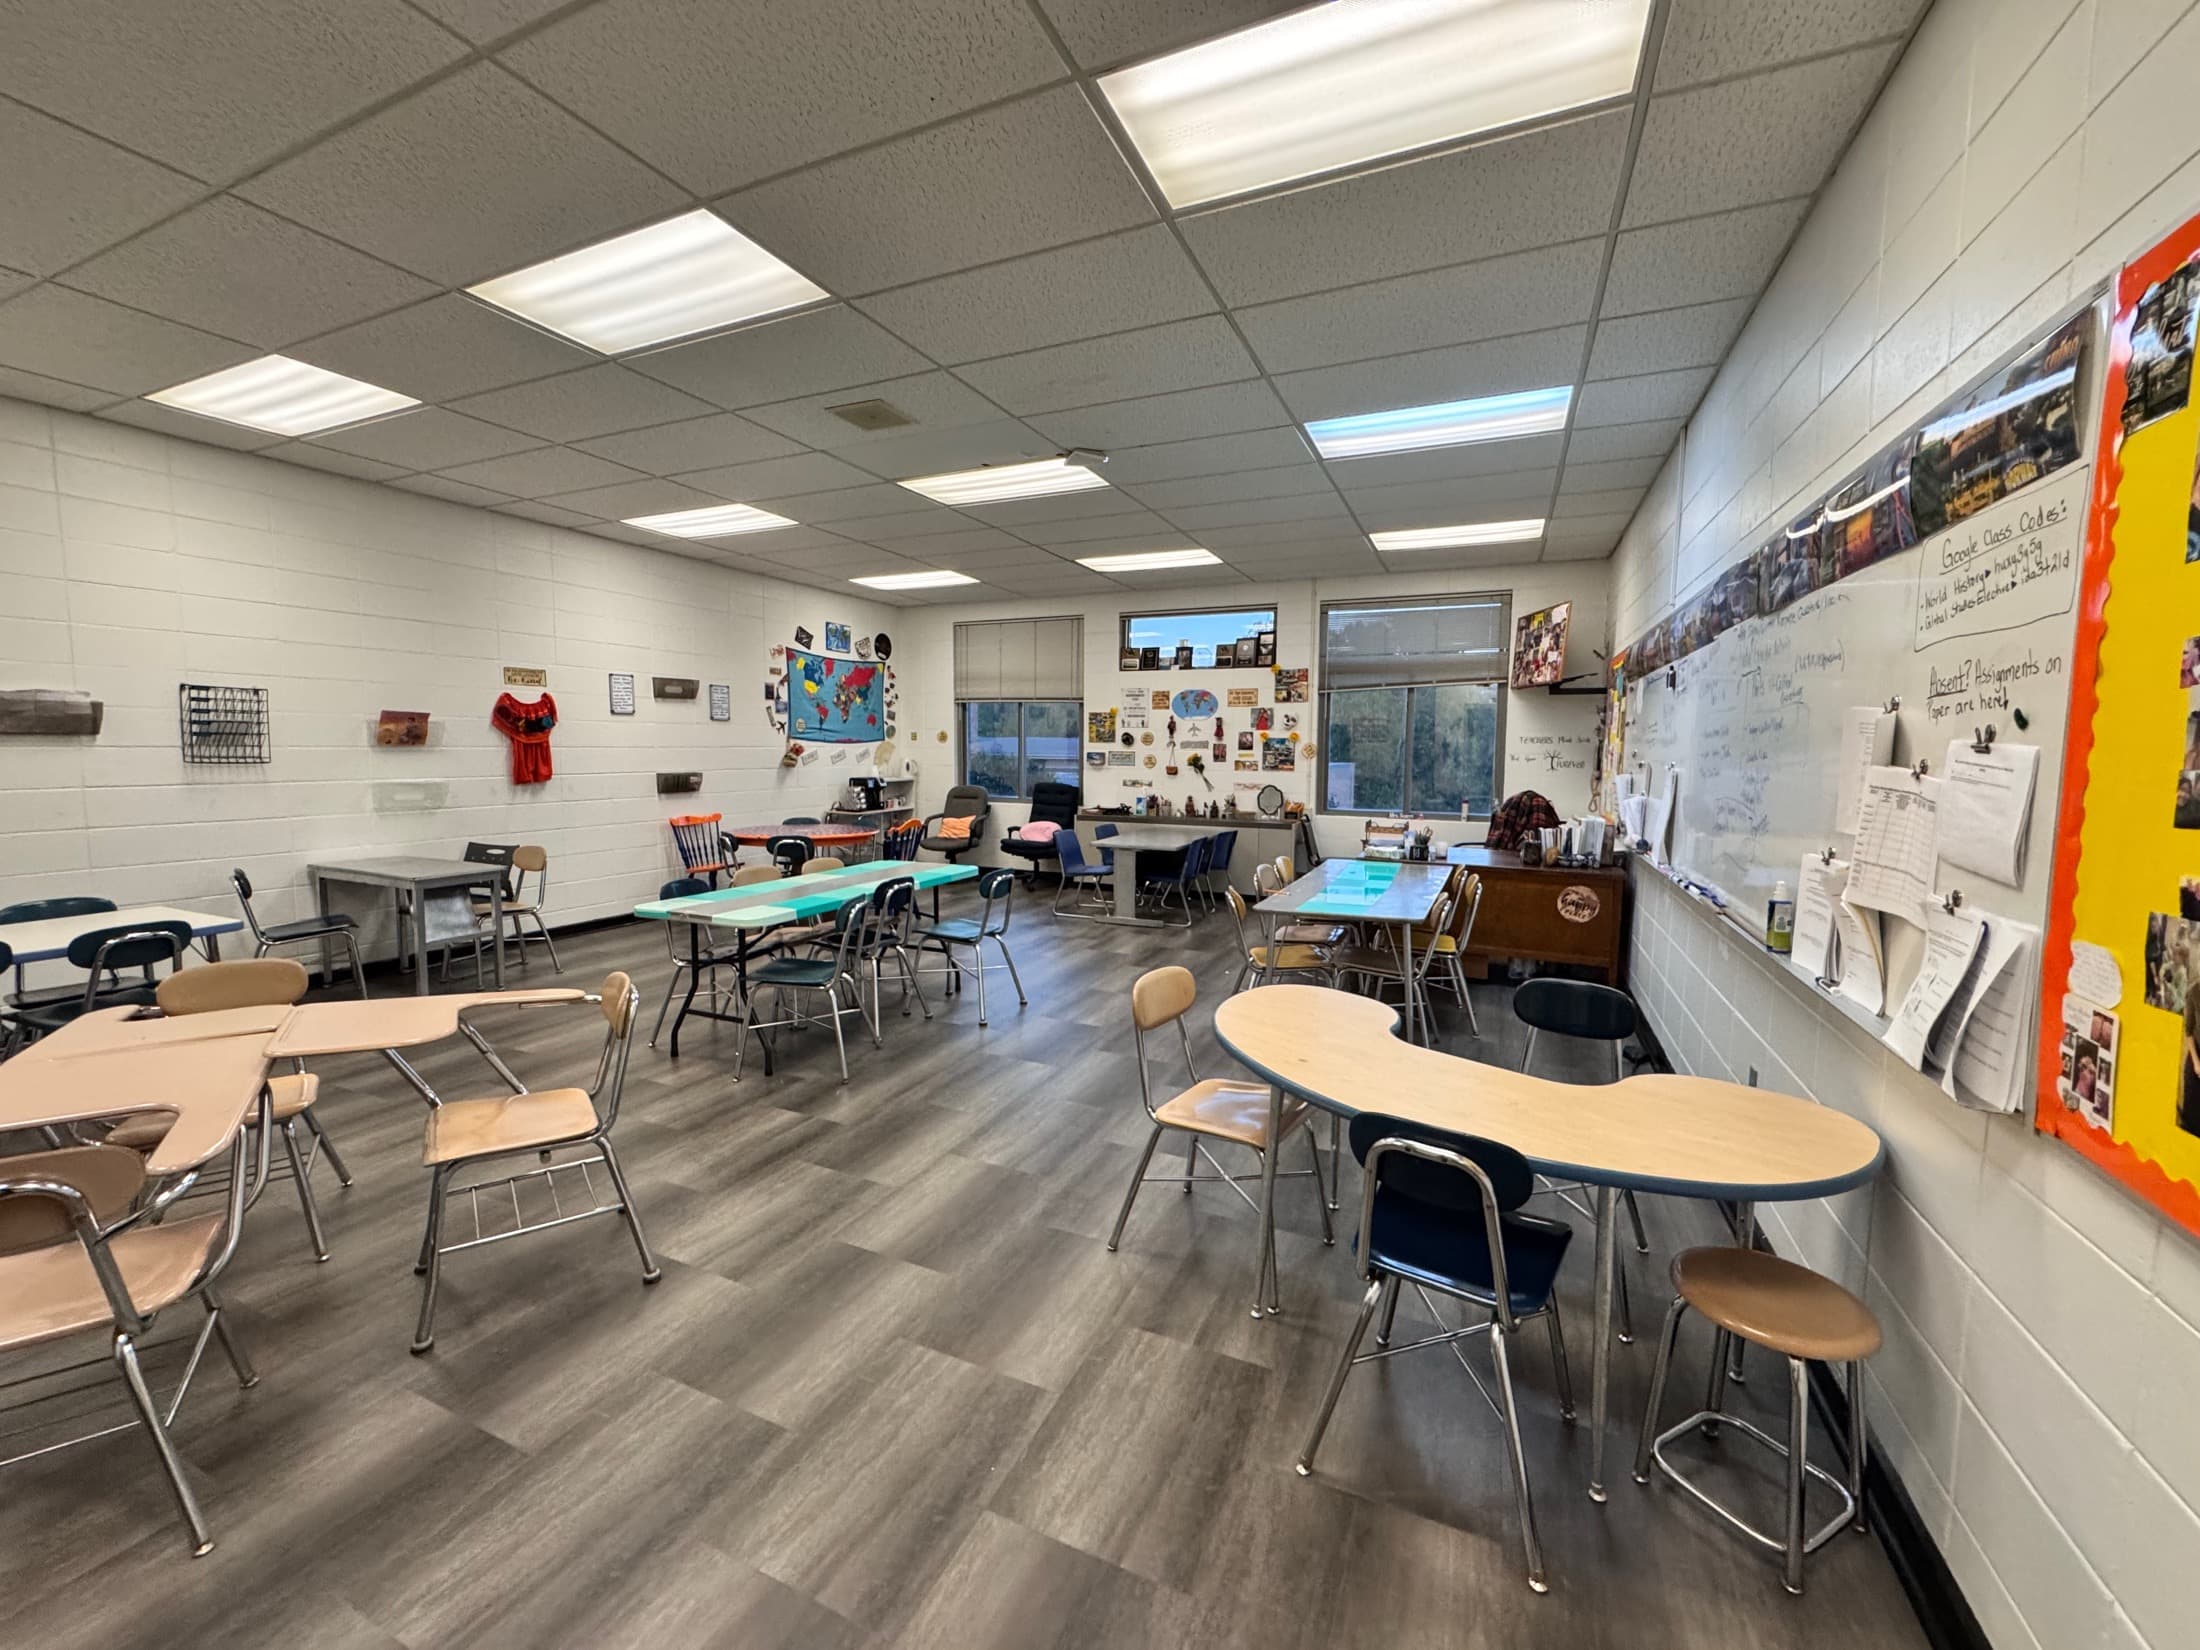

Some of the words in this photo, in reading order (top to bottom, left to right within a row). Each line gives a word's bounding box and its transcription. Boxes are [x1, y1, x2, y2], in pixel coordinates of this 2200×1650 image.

[1942, 536, 1978, 573] Google
[1983, 524, 2012, 547] Class
[2020, 499, 2068, 532] Codes:
[1929, 659, 1972, 696] Absent?
[1975, 648, 2040, 693] Assignments
[2045, 656, 2062, 674] on
[1955, 701, 1975, 715] are
